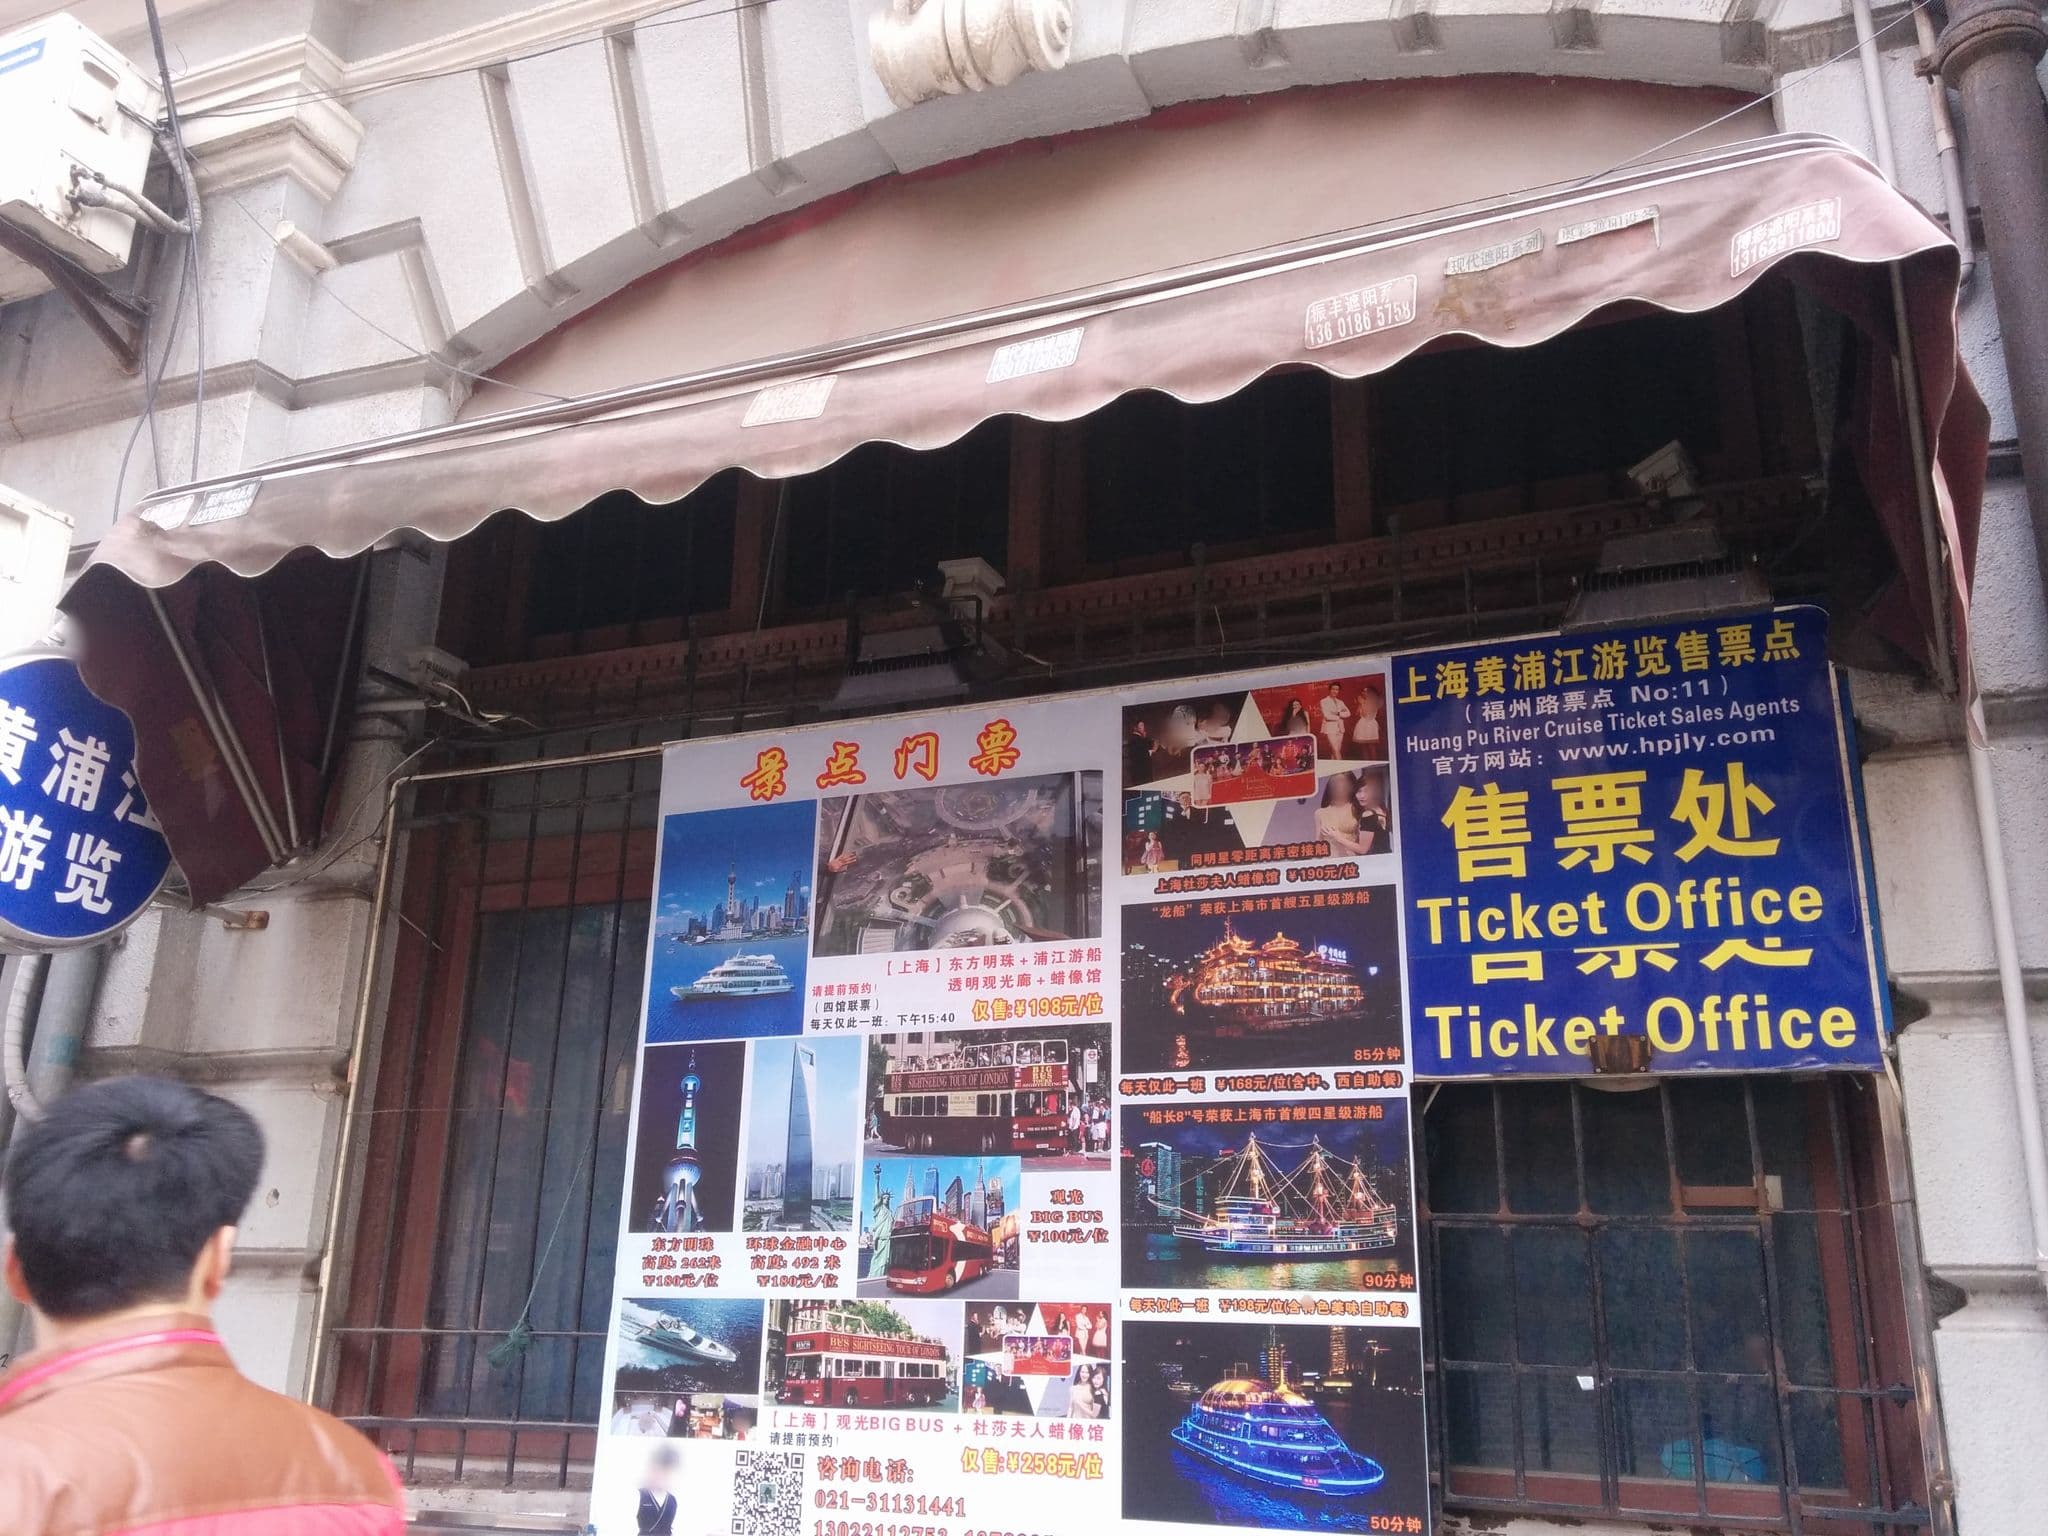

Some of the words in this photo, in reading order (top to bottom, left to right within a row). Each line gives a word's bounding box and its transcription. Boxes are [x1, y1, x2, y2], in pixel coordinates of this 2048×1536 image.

[1450, 232, 1540, 274] 现代遮阳系列
[1309, 321, 1333, 346] 136
[1337, 310, 1372, 338] 0186
[1376, 301, 1411, 327] 5758
[1398, 618, 1802, 705] 上海黄浦江游览售票点
[1407, 734, 1463, 753] Huang
[1467, 729, 1489, 747] Pu
[1494, 725, 1540, 744] River
[1544, 717, 1604, 738] Cruise
[1607, 710, 1667, 731] Ticket
[1671, 705, 1724, 726] Sales
[1729, 697, 1801, 722] Agents
[740, 718, 1021, 801] 景点门票
[1432, 747, 1544, 776] 官方网站：
[1558, 728, 1776, 762] www.hpjly.com
[1440, 761, 1782, 883] 售票处
[1154, 868, 1280, 894] 上海杜莎夫人蜡像馆
[1417, 891, 1608, 945] Ticket
[1625, 877, 1824, 932] Office
[897, 1012, 955, 1026] 下午15:40
[1425, 1003, 1625, 1059] Ticket
[1646, 994, 1856, 1054] Office
[1353, 1047, 1401, 1062] 85分钟
[949, 1074, 967, 1087] TOUR
[968, 1073, 978, 1086] OF
[980, 1071, 1009, 1086] LONDON
[1119, 1077, 1206, 1096] 每天仅此一班
[1050, 1189, 1084, 1205] 观光
[1030, 1211, 1064, 1223] BIG
[1067, 1210, 1103, 1223] BUS
[652, 1237, 714, 1252] 东方明珠
[746, 1236, 847, 1252] 环球金融中心
[1363, 1273, 1415, 1290] 90分钟
[1130, 1296, 1210, 1313] 每天仅此一班
[830, 1337, 849, 1347] BUS
[906, 1417, 944, 1433] BUS
[973, 1419, 1105, 1442] 杜莎夫人蜡像馆
[817, 1455, 914, 1484] 咨询电话:
[814, 1488, 966, 1518] 021-31131441
[1370, 1516, 1423, 1532] 50分钟
